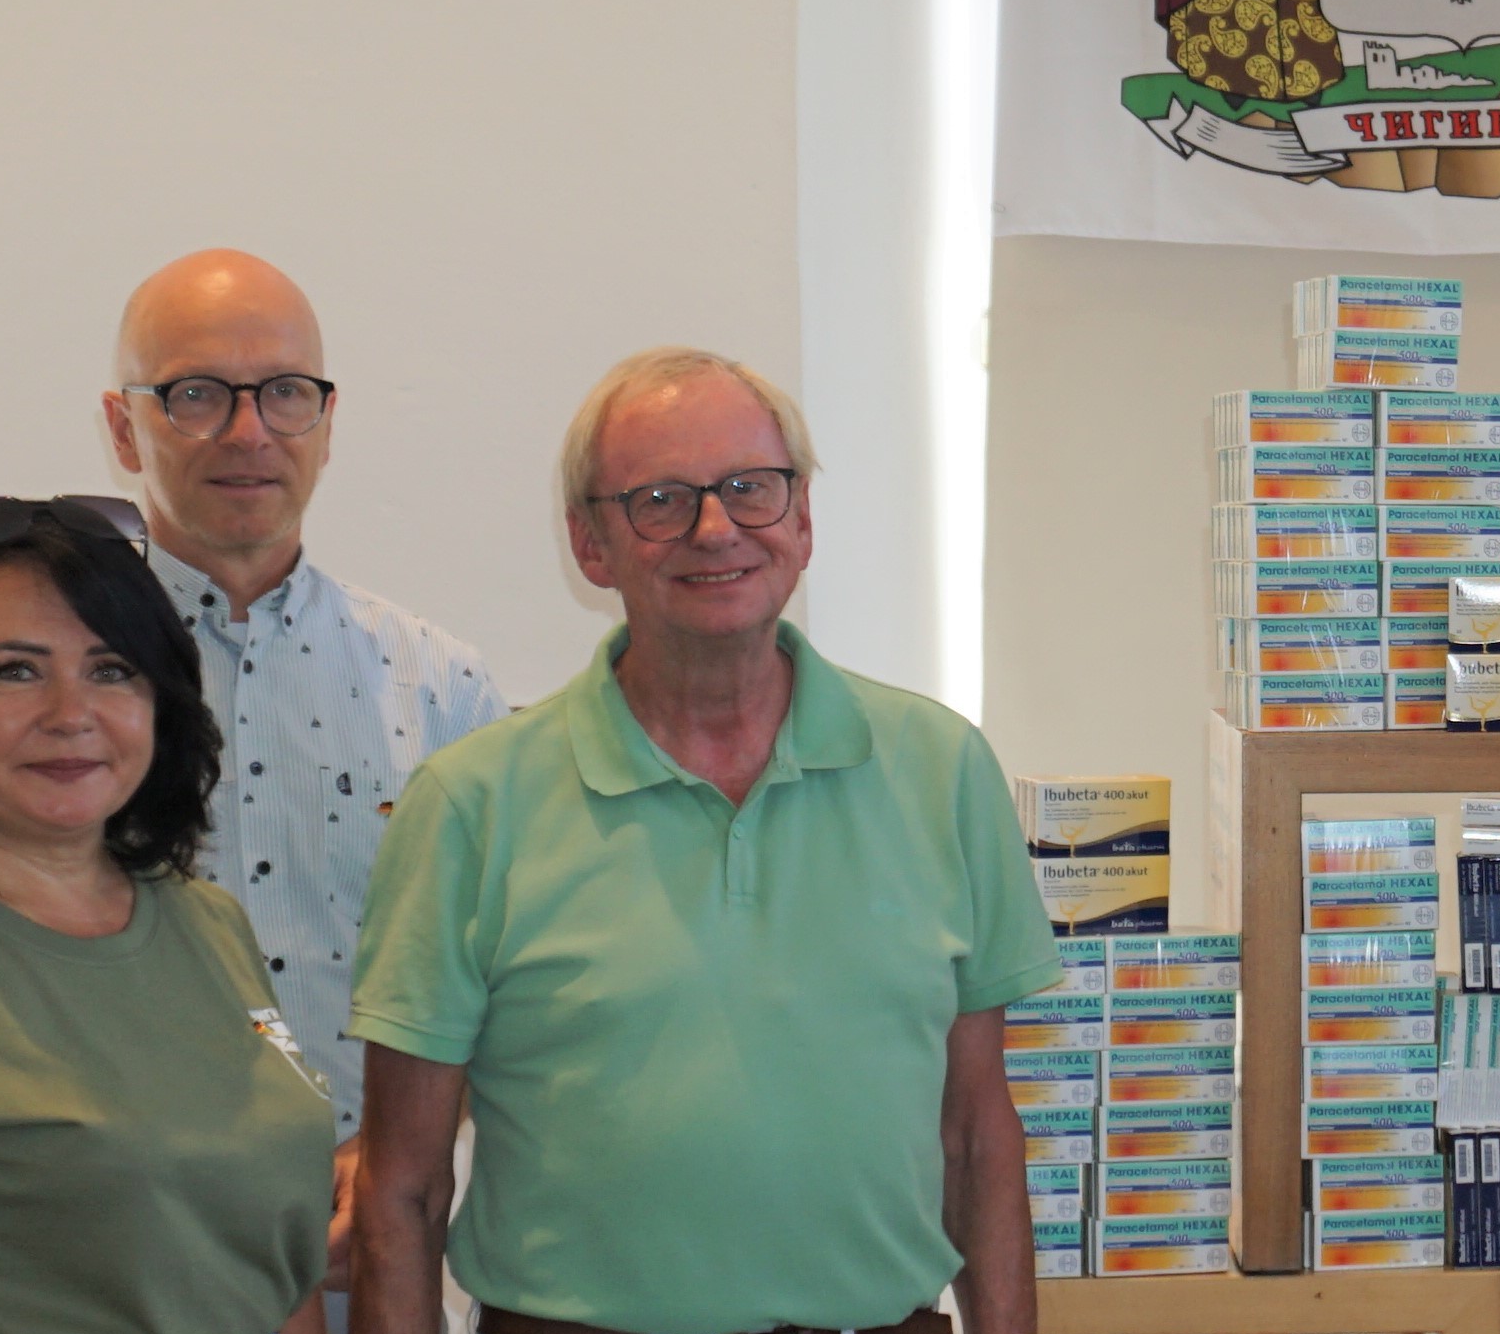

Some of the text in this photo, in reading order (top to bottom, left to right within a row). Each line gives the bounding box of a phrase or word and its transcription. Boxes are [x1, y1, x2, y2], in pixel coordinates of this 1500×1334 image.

[1340, 279, 1459, 293] Paracetamol HEXAL
[1337, 335, 1456, 349] Paracetamol HEXAL
[1252, 395, 1369, 404] Paracetamol HEXAL
[1389, 396, 1461, 406] Paracetamol
[1388, 453, 1459, 462] Paracetamol
[1389, 509, 1500, 520] Paracetamol HEXAL
[1259, 565, 1375, 576] Paracetamol HEXAL
[1263, 678, 1379, 690] Paracetamol HEXAL
[1044, 788, 1148, 801] Ibubeta 400 akut
[1044, 865, 1148, 879] Ibubeta 400 akut
[1312, 877, 1433, 891] Paracetamol HEXAL
[1310, 992, 1431, 1004] Paracetamol HEXAL
[1110, 1105, 1228, 1119] Paracetamol HEXAL
[1310, 1104, 1430, 1116] Paracetamol HEXAL
[1324, 1215, 1441, 1229] Paracetamol HEXAL
